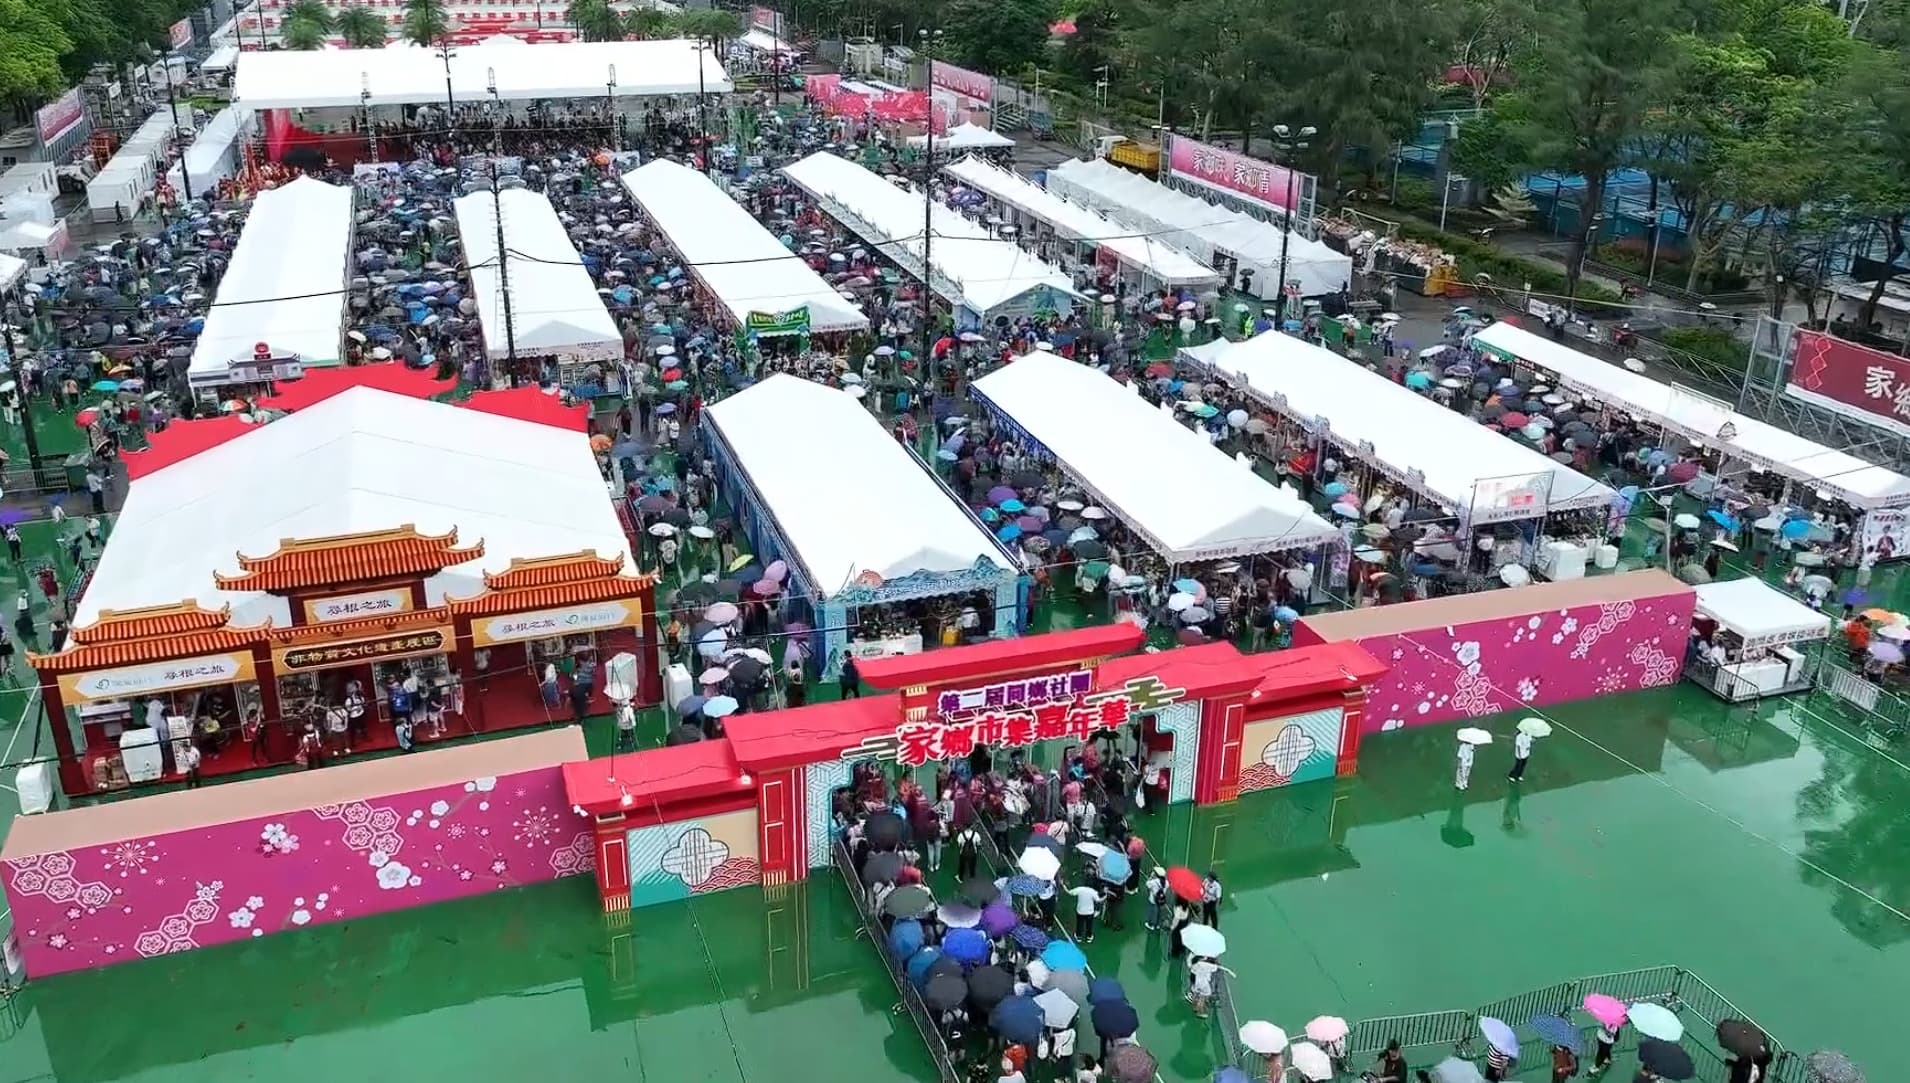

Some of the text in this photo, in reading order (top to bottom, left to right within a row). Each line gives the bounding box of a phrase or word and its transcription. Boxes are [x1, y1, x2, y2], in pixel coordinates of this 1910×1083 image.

[327, 599, 392, 616] 尋根之旅
[502, 618, 556, 634] 尋根之旅
[164, 665, 225, 680] 尋根之旅
[938, 670, 1092, 715] 第二屆同鄉社團
[897, 697, 1130, 766] 家鄉市集嘉年華
